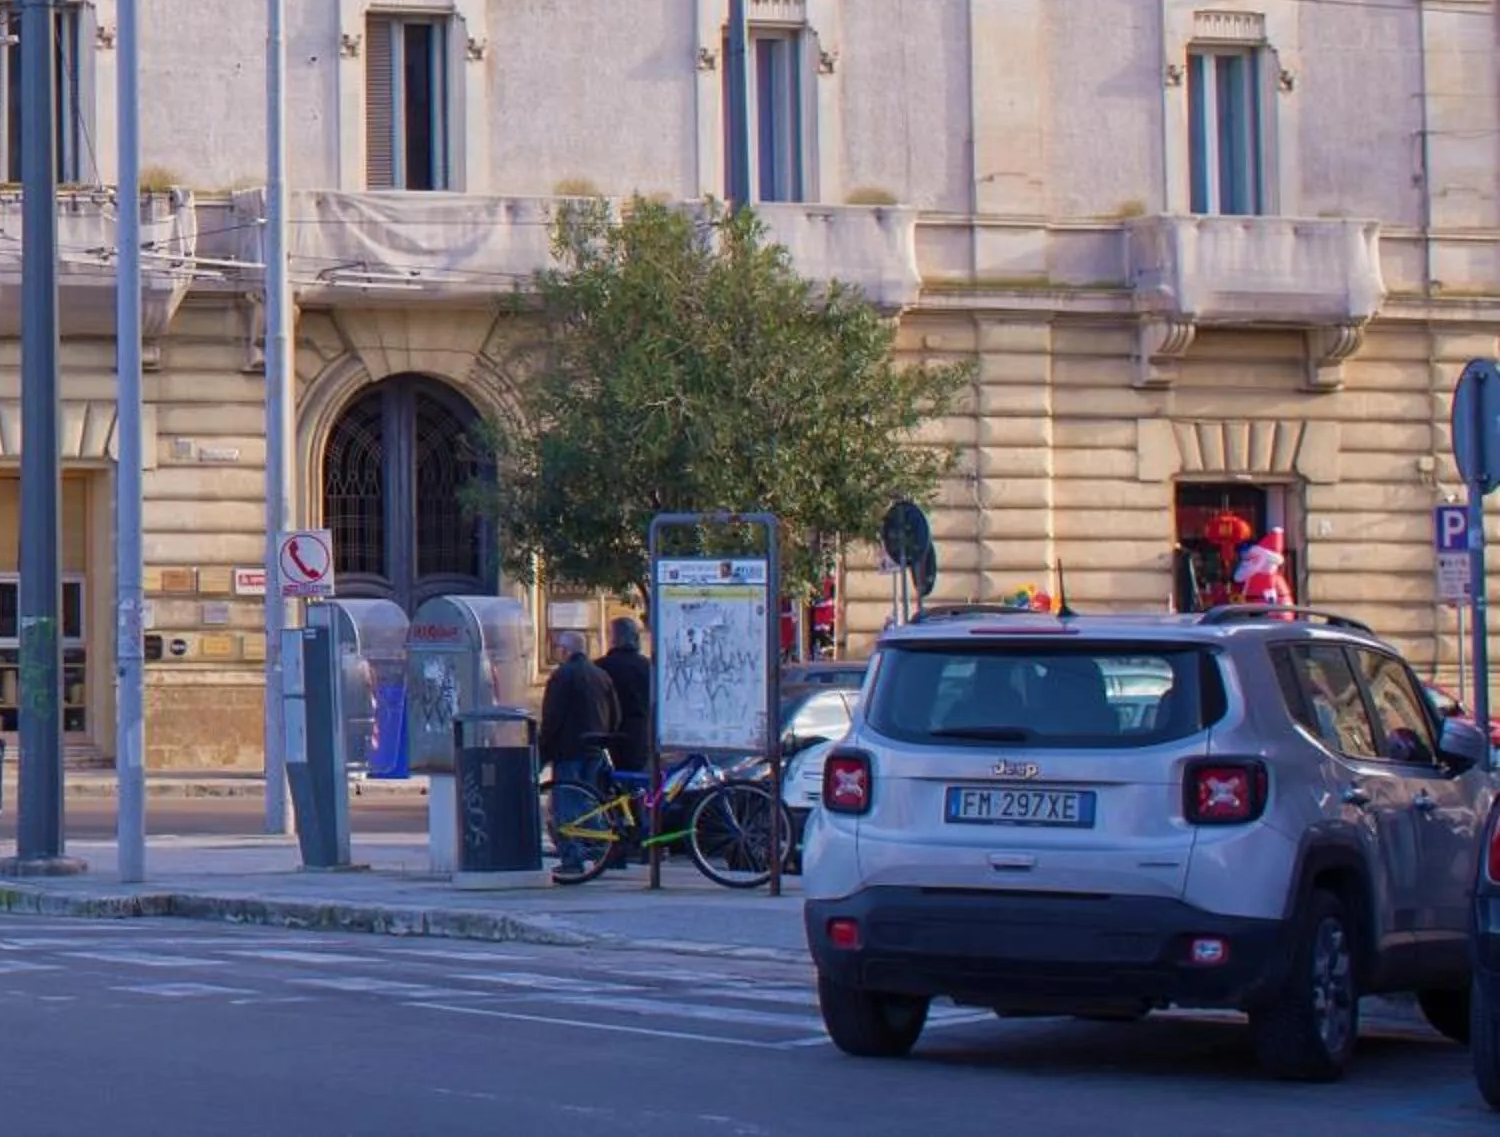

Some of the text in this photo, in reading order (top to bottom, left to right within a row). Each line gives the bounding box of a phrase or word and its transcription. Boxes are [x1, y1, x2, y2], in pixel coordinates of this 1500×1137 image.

[1443, 510, 1465, 548] P
[993, 759, 1039, 778] Jeep
[962, 792, 1077, 820] FM 297XE
